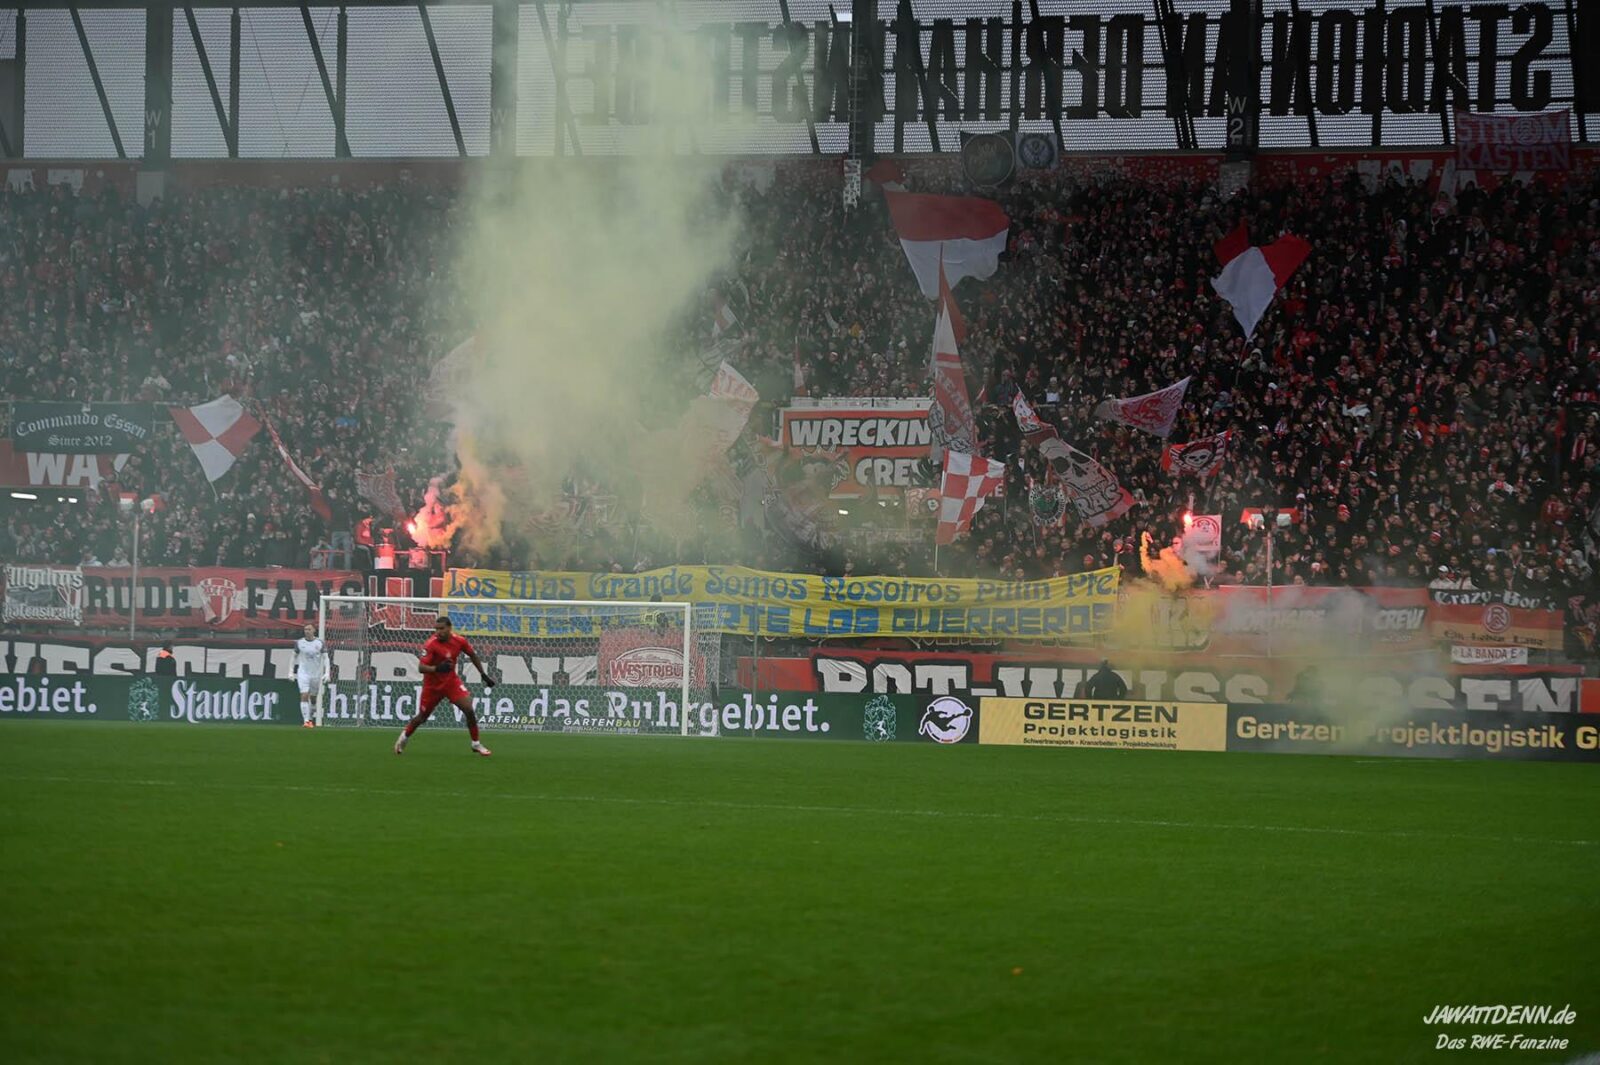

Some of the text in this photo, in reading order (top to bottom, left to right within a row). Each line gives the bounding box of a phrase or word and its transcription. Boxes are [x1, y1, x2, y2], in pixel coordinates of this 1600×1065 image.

[1228, 96, 1247, 114] W
[1229, 117, 1245, 137] 2
[1456, 143, 1570, 170] KASTEN
[16, 412, 147, 438] Commando Essen
[789, 418, 932, 447] WRECKIN
[48, 434, 81, 447] Since
[447, 568, 498, 598] Los
[588, 567, 694, 599] Grande
[704, 565, 808, 601] Somos
[820, 575, 961, 603] Nosotros
[85, 575, 192, 616] RUDE
[245, 577, 365, 620] FANS
[803, 607, 880, 635] LOS
[892, 604, 1115, 636] GUERREROS
[1460, 648, 1473, 659] LA
[1475, 648, 1508, 660] BANDA
[170, 679, 279, 724] Stauder
[529, 688, 590, 717] das
[605, 690, 831, 737] Ruhrgebiet.
[1023, 702, 1178, 724] GERTZEN
[478, 715, 546, 725] ARTENBAU
[563, 717, 641, 728] GARTENBAU
[1023, 723, 1177, 740] Projektlogistik
[1236, 715, 1345, 742] Gertzen
[1576, 726, 1600, 750] G
